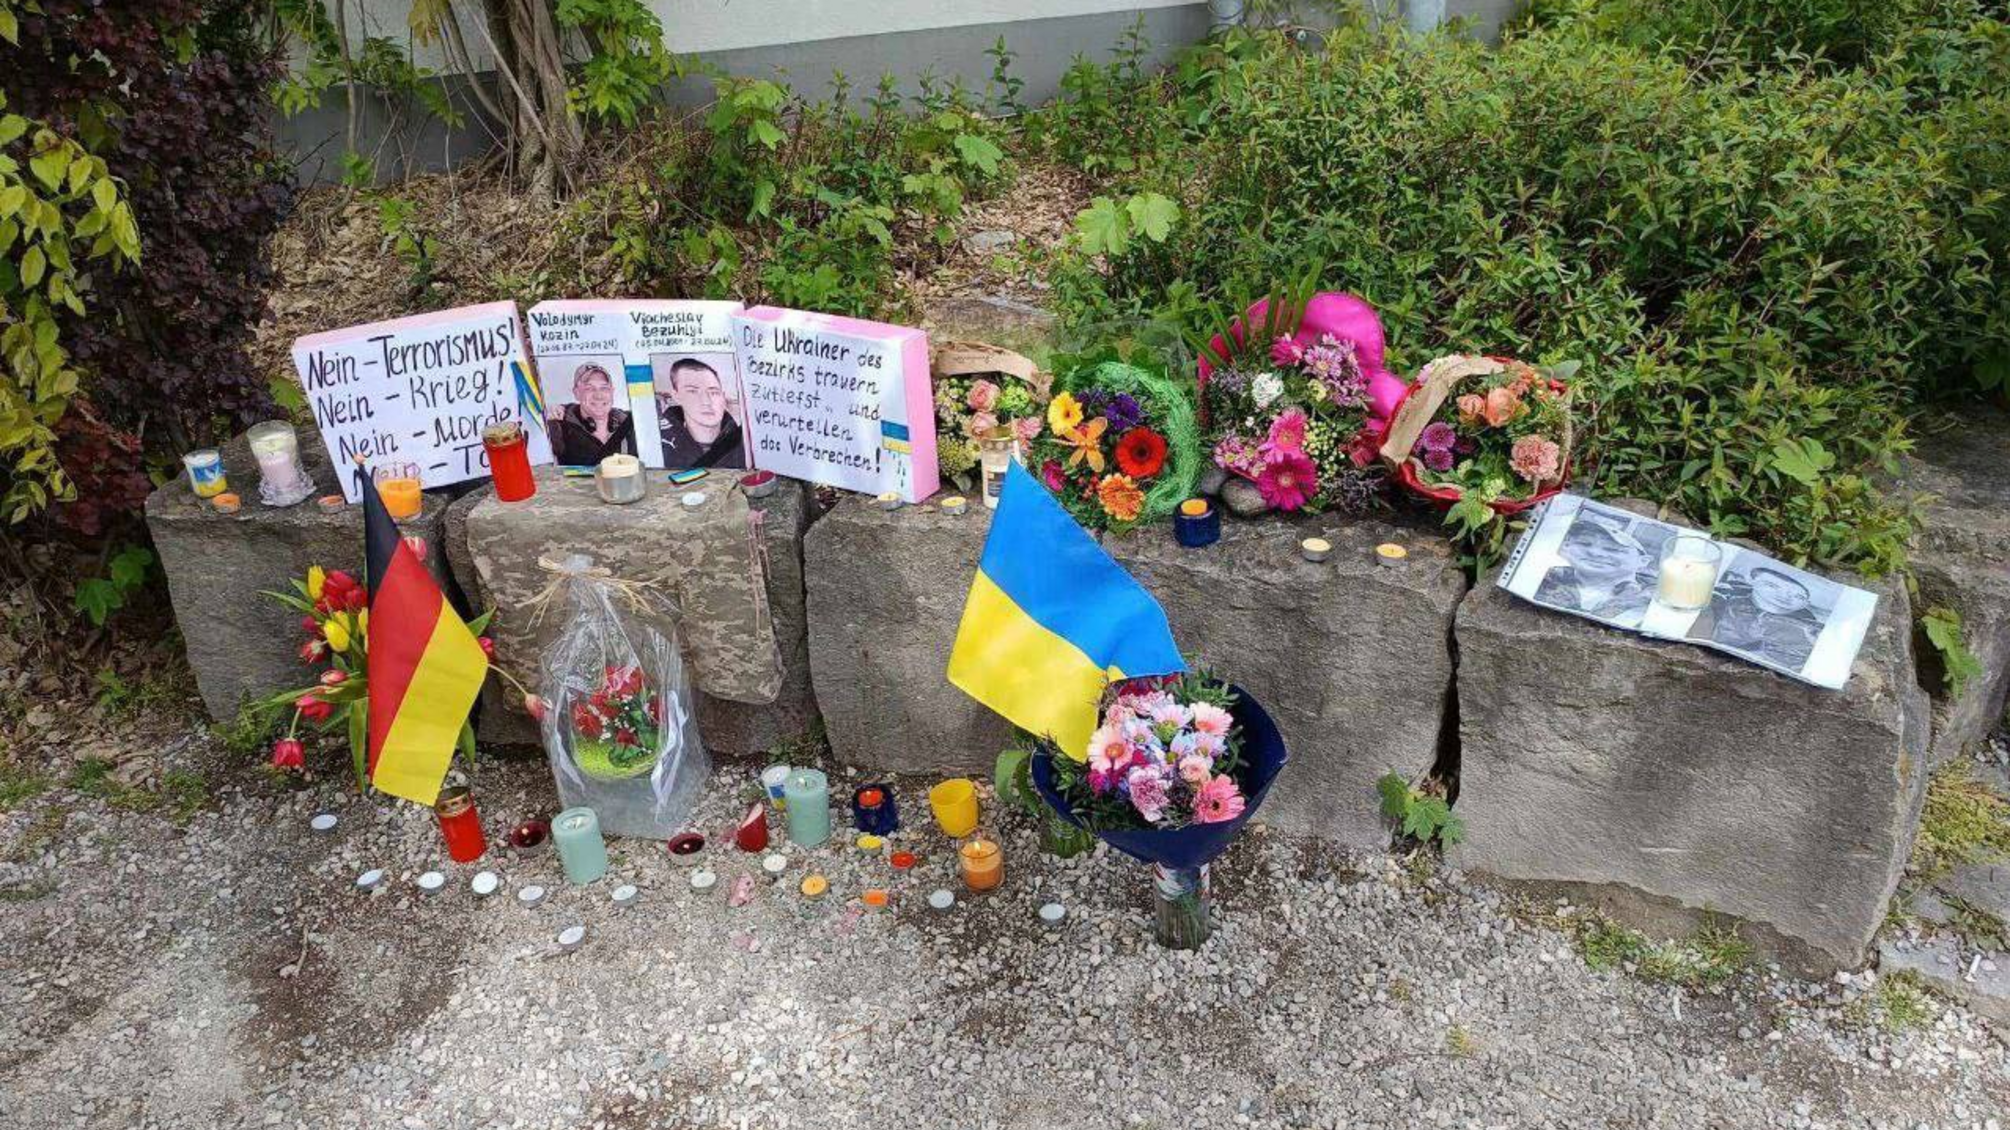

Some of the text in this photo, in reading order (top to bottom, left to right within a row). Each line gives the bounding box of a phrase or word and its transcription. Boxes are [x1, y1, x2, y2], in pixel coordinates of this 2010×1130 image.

[629, 311, 704, 324] Viacheslav
[743, 325, 882, 369] Die Ukrainer des
[308, 350, 359, 391] Nein
[814, 364, 880, 395] trauern
[317, 394, 374, 429] Nein
[409, 360, 504, 410] Krieg!
[848, 402, 880, 421] und
[754, 408, 853, 441] verurteilen
[338, 428, 399, 465] Nein
[761, 434, 881, 474] das Verbrechen!
